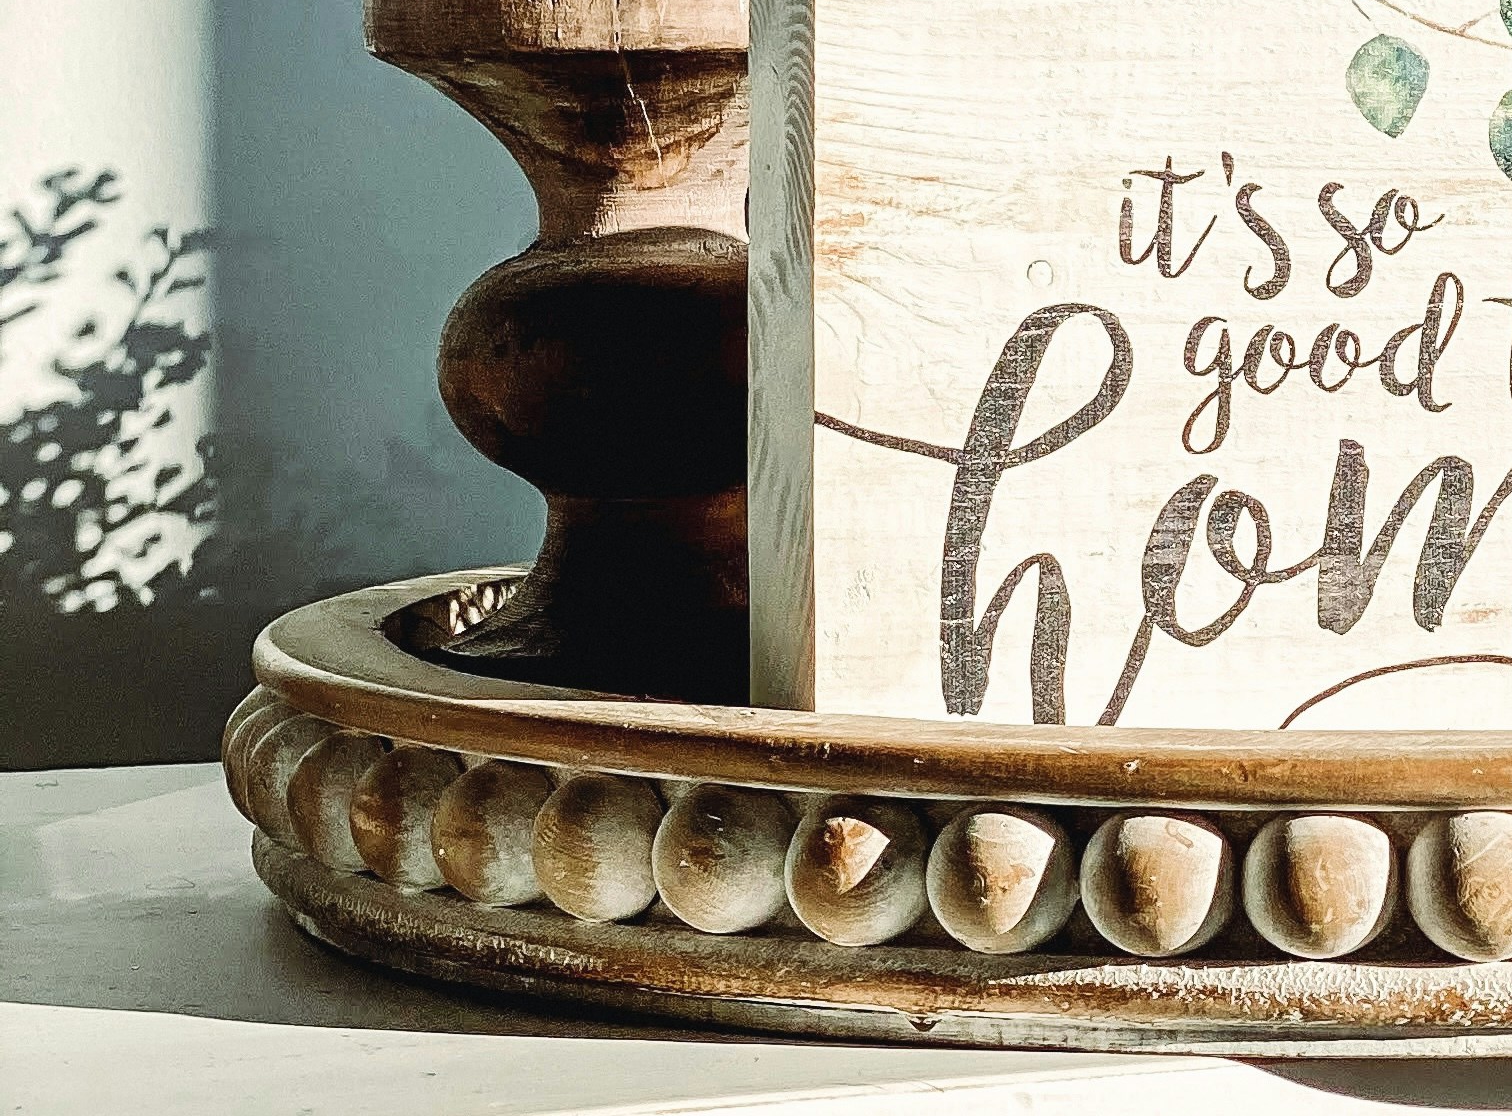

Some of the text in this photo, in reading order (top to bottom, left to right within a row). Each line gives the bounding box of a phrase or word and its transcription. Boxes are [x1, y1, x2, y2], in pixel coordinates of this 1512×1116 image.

[1118, 151, 1446, 300] it's so
[1183, 271, 1466, 455] good
